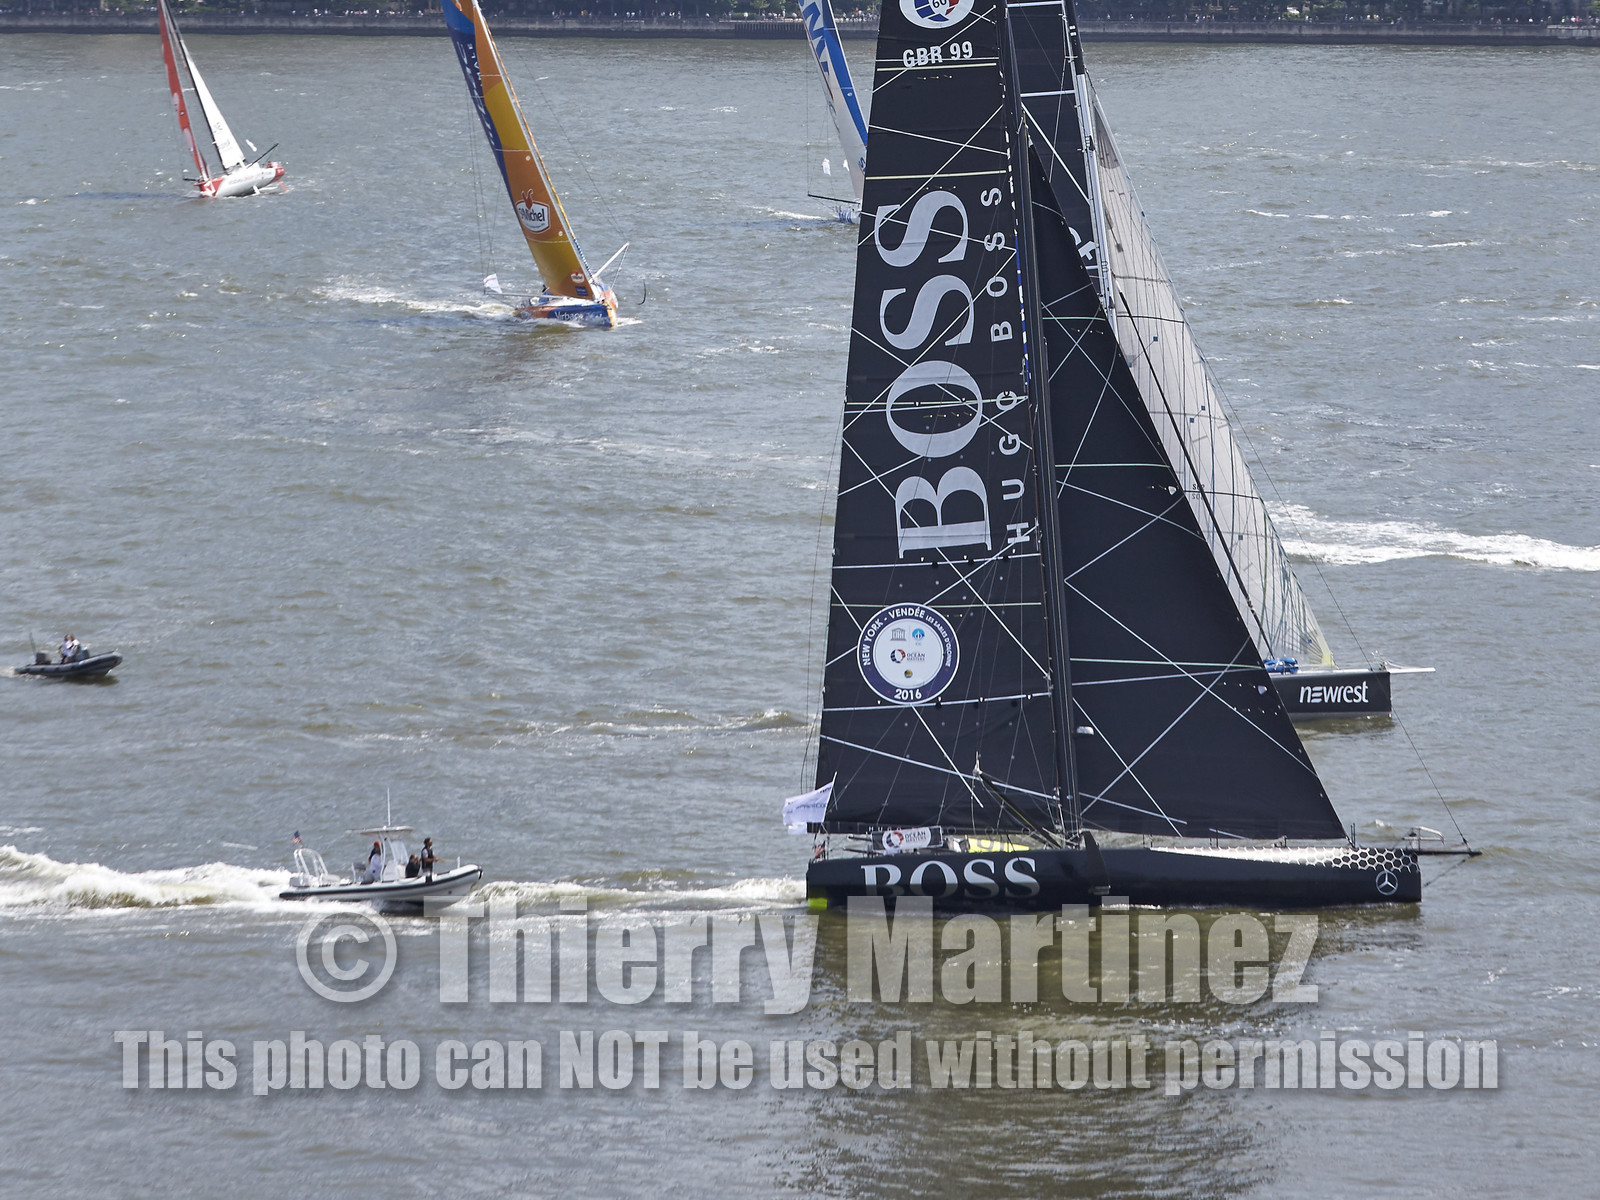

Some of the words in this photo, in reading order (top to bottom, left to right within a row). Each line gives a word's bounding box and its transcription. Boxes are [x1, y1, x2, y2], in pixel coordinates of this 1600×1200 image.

[902, 45, 943, 68] GBR
[949, 40, 973, 60] 99
[980, 187, 1014, 342] BOSS
[874, 190, 992, 560] BOSS
[996, 391, 1031, 544] HUGO
[888, 606, 926, 619] VENDÉE
[864, 618, 884, 642] YORK
[861, 644, 871, 666] NEW
[894, 689, 922, 700] 2016
[861, 857, 1041, 899] BOSS
